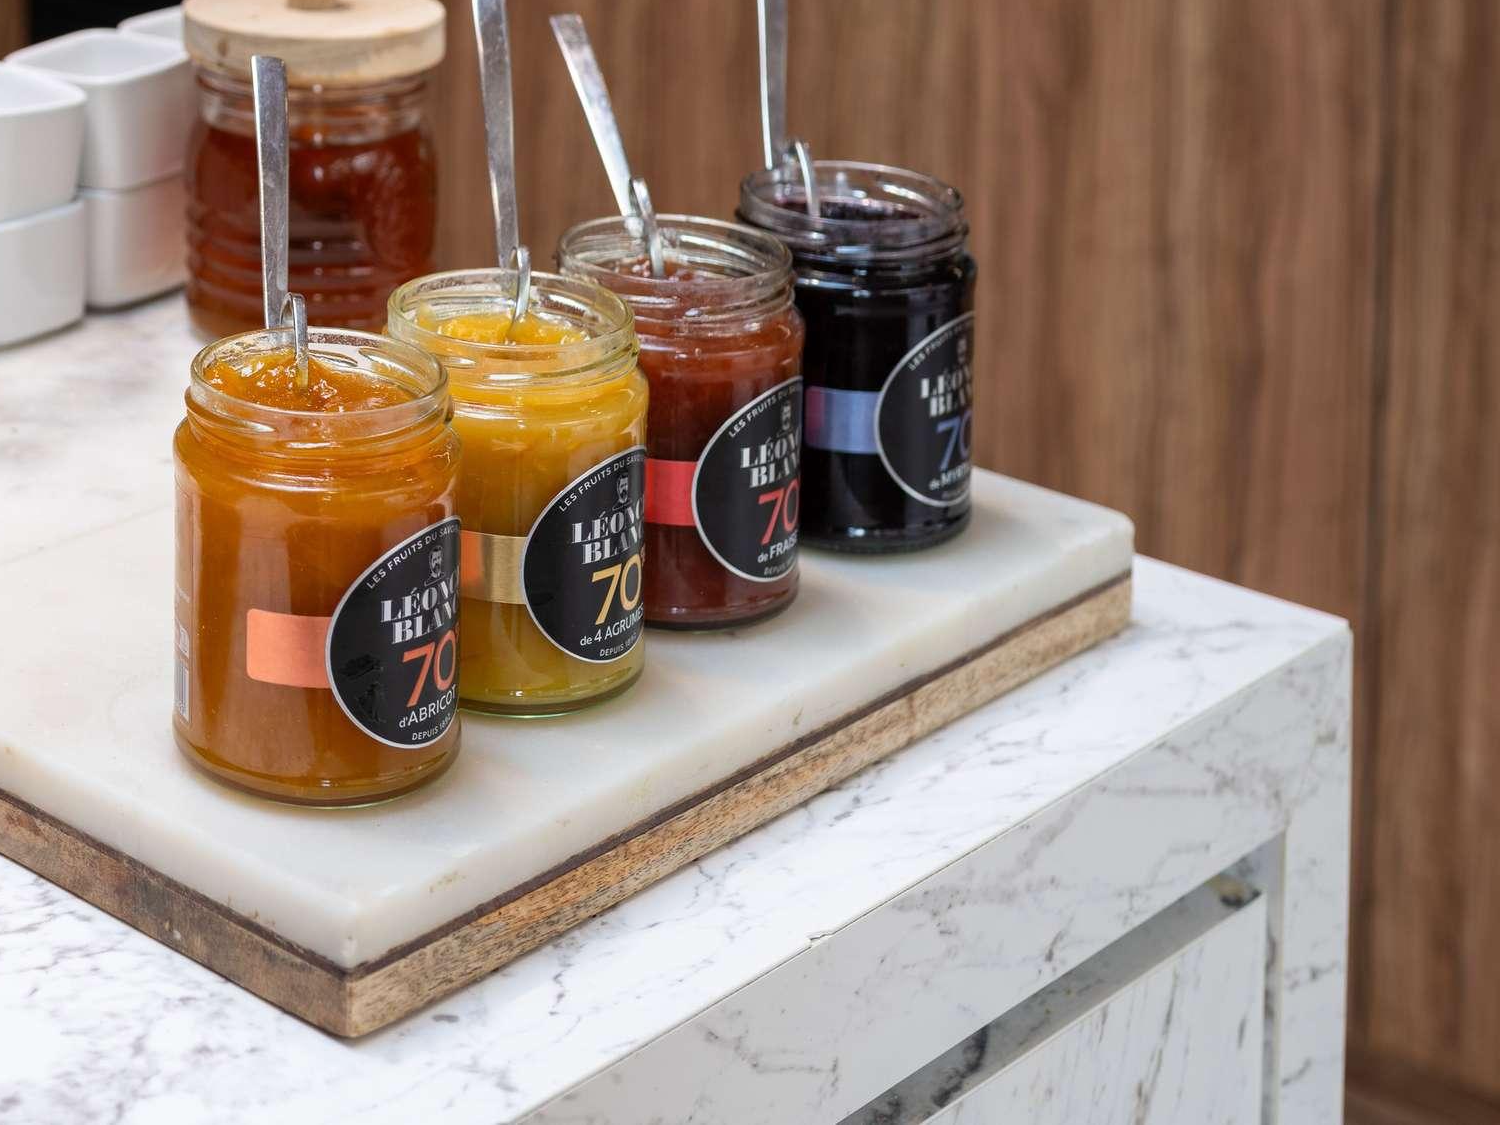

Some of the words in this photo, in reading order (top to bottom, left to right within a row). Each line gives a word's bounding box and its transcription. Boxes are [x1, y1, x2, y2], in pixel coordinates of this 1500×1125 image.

[559, 492, 577, 512] LES
[578, 467, 612, 495] FRUITS
[366, 567, 386, 589] LES
[387, 539, 423, 571] FRUITS
[580, 635, 593, 646] de
[594, 629, 602, 642] 4
[604, 602, 644, 640] AGRUMES
[398, 683, 457, 728] d'ABRICOT
